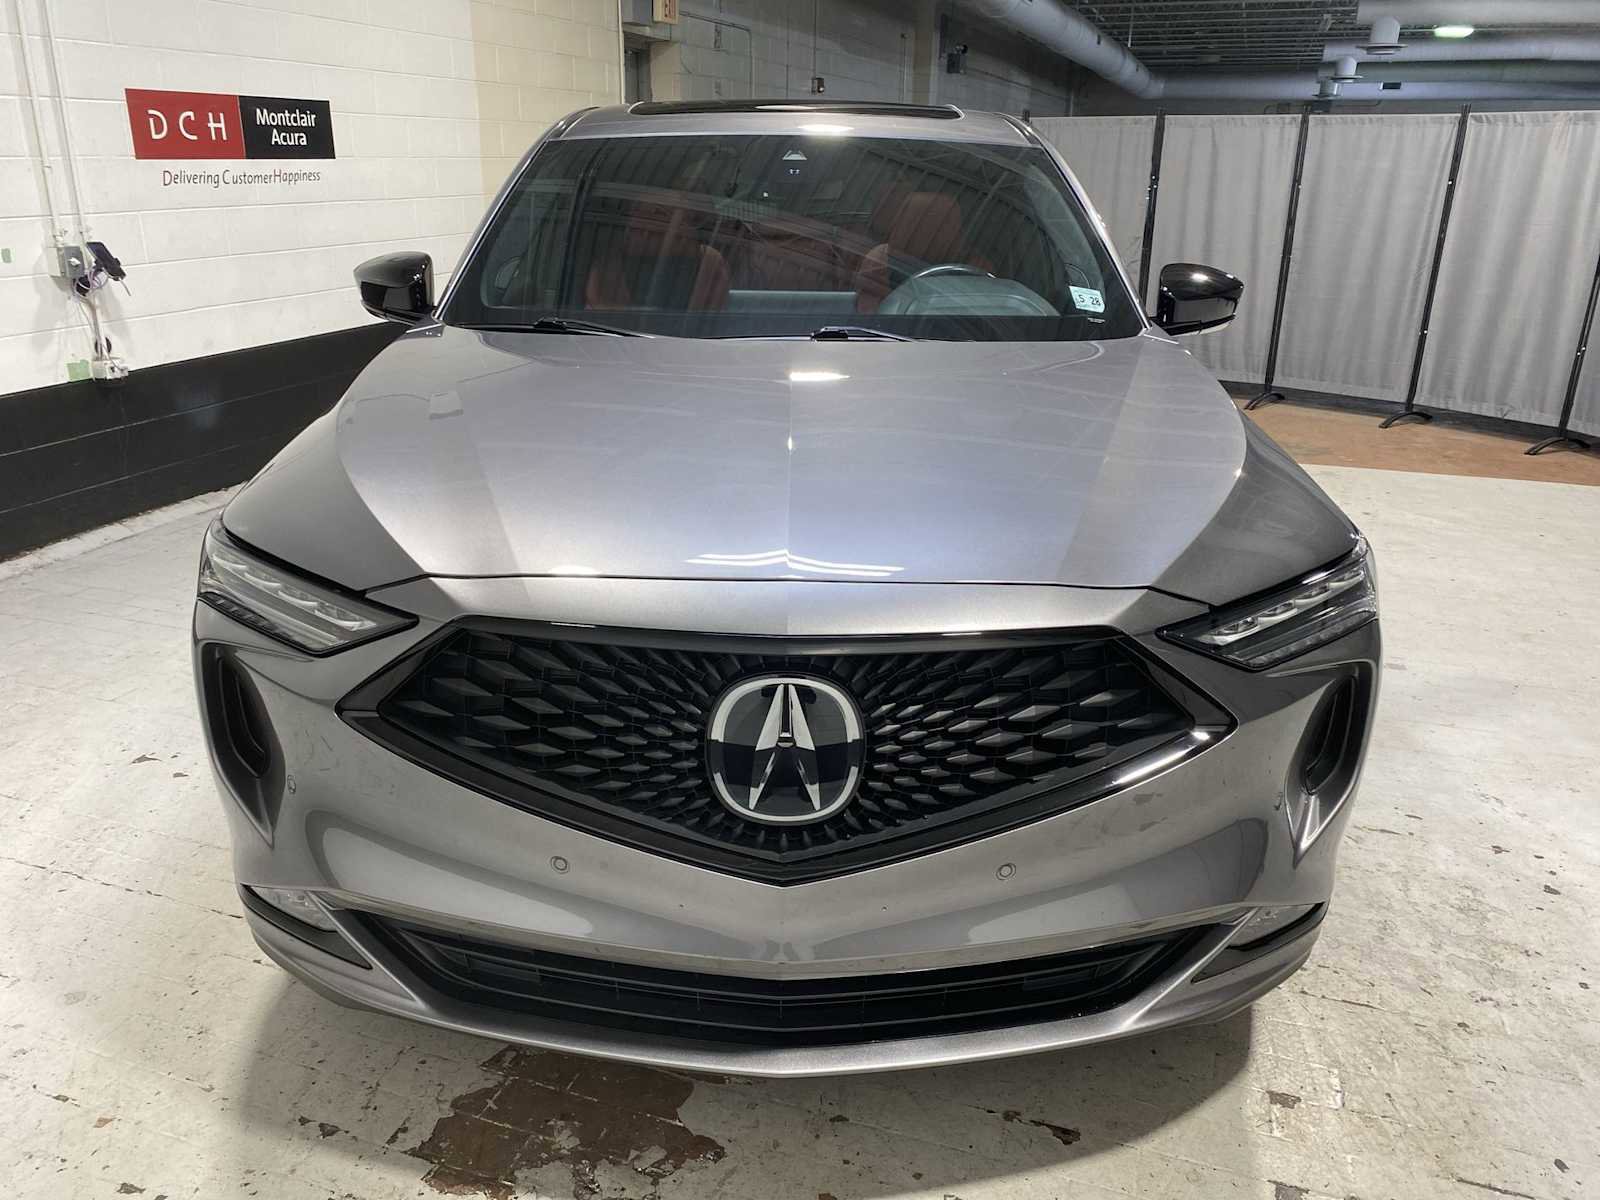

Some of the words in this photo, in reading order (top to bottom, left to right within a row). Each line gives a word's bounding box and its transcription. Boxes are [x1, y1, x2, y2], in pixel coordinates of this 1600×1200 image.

[256, 108, 316, 127] Montclair
[271, 129, 307, 146] Acura
[163, 170, 220, 188] Delivering
